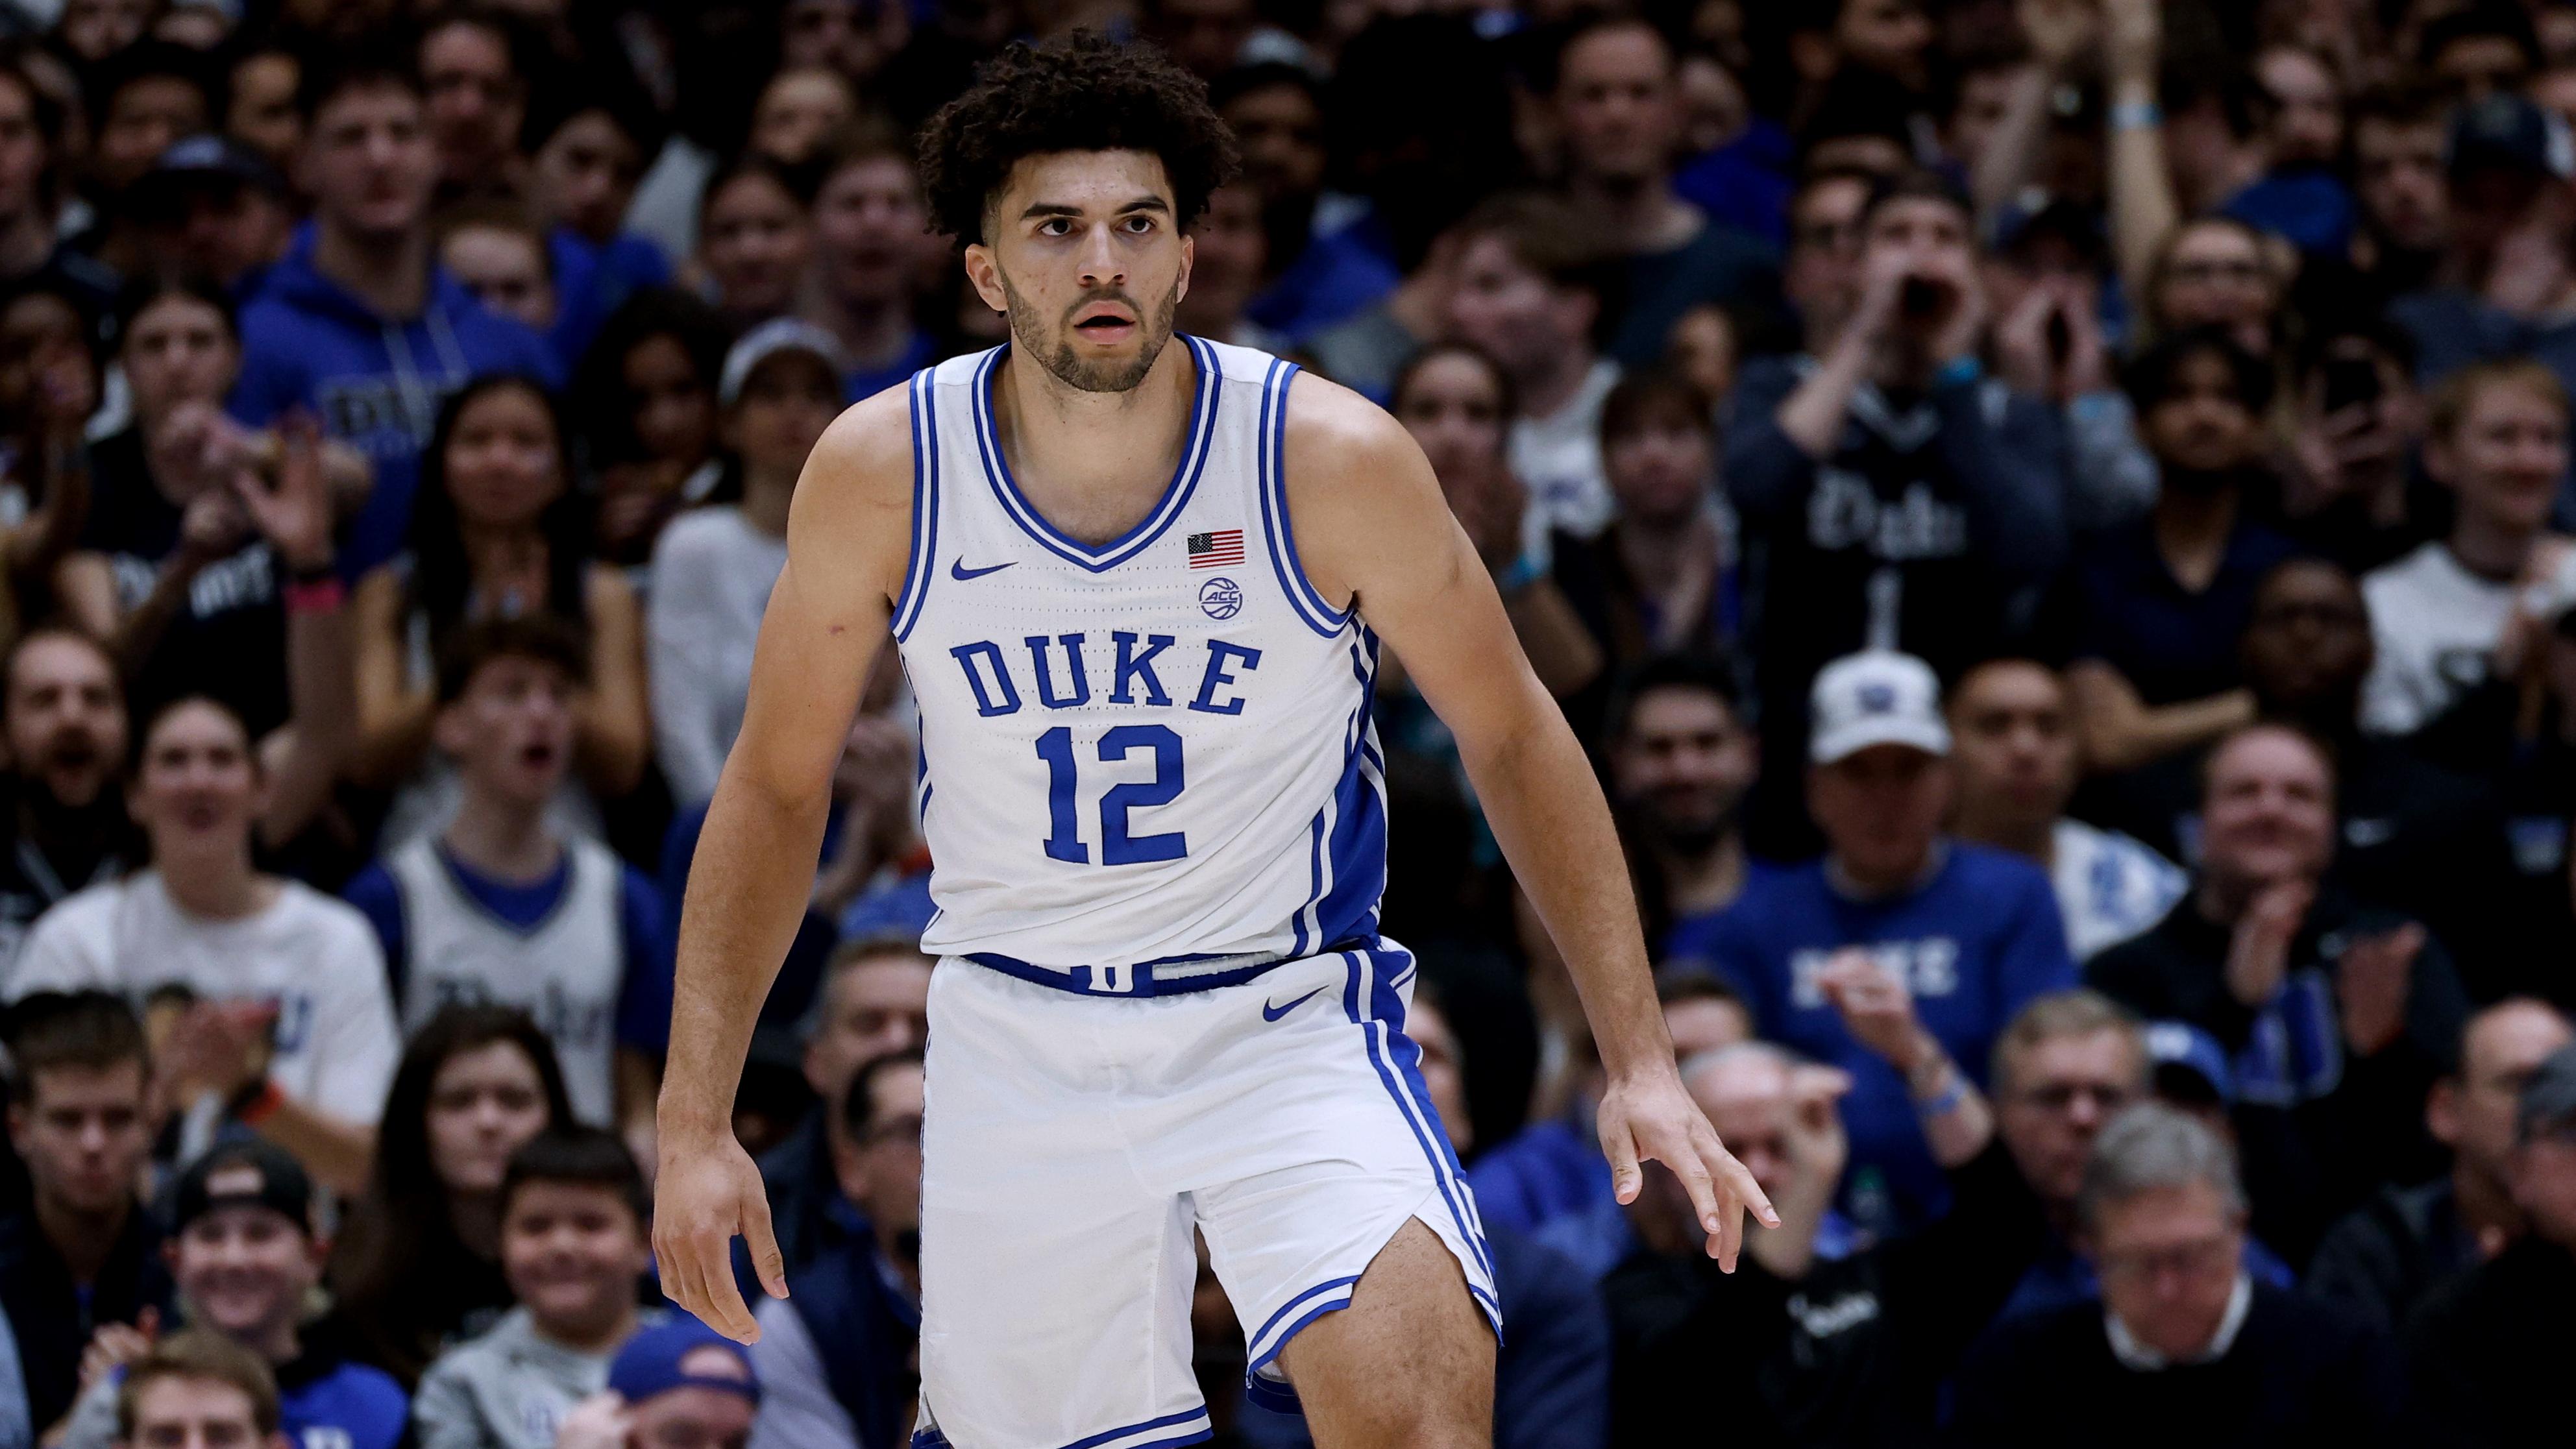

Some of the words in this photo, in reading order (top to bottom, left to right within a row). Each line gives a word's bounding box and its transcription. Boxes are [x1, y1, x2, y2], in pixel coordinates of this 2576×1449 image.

[1205, 591, 1240, 602] ACC
[950, 631, 1262, 717] DUKE
[1035, 724, 1188, 866] 12
